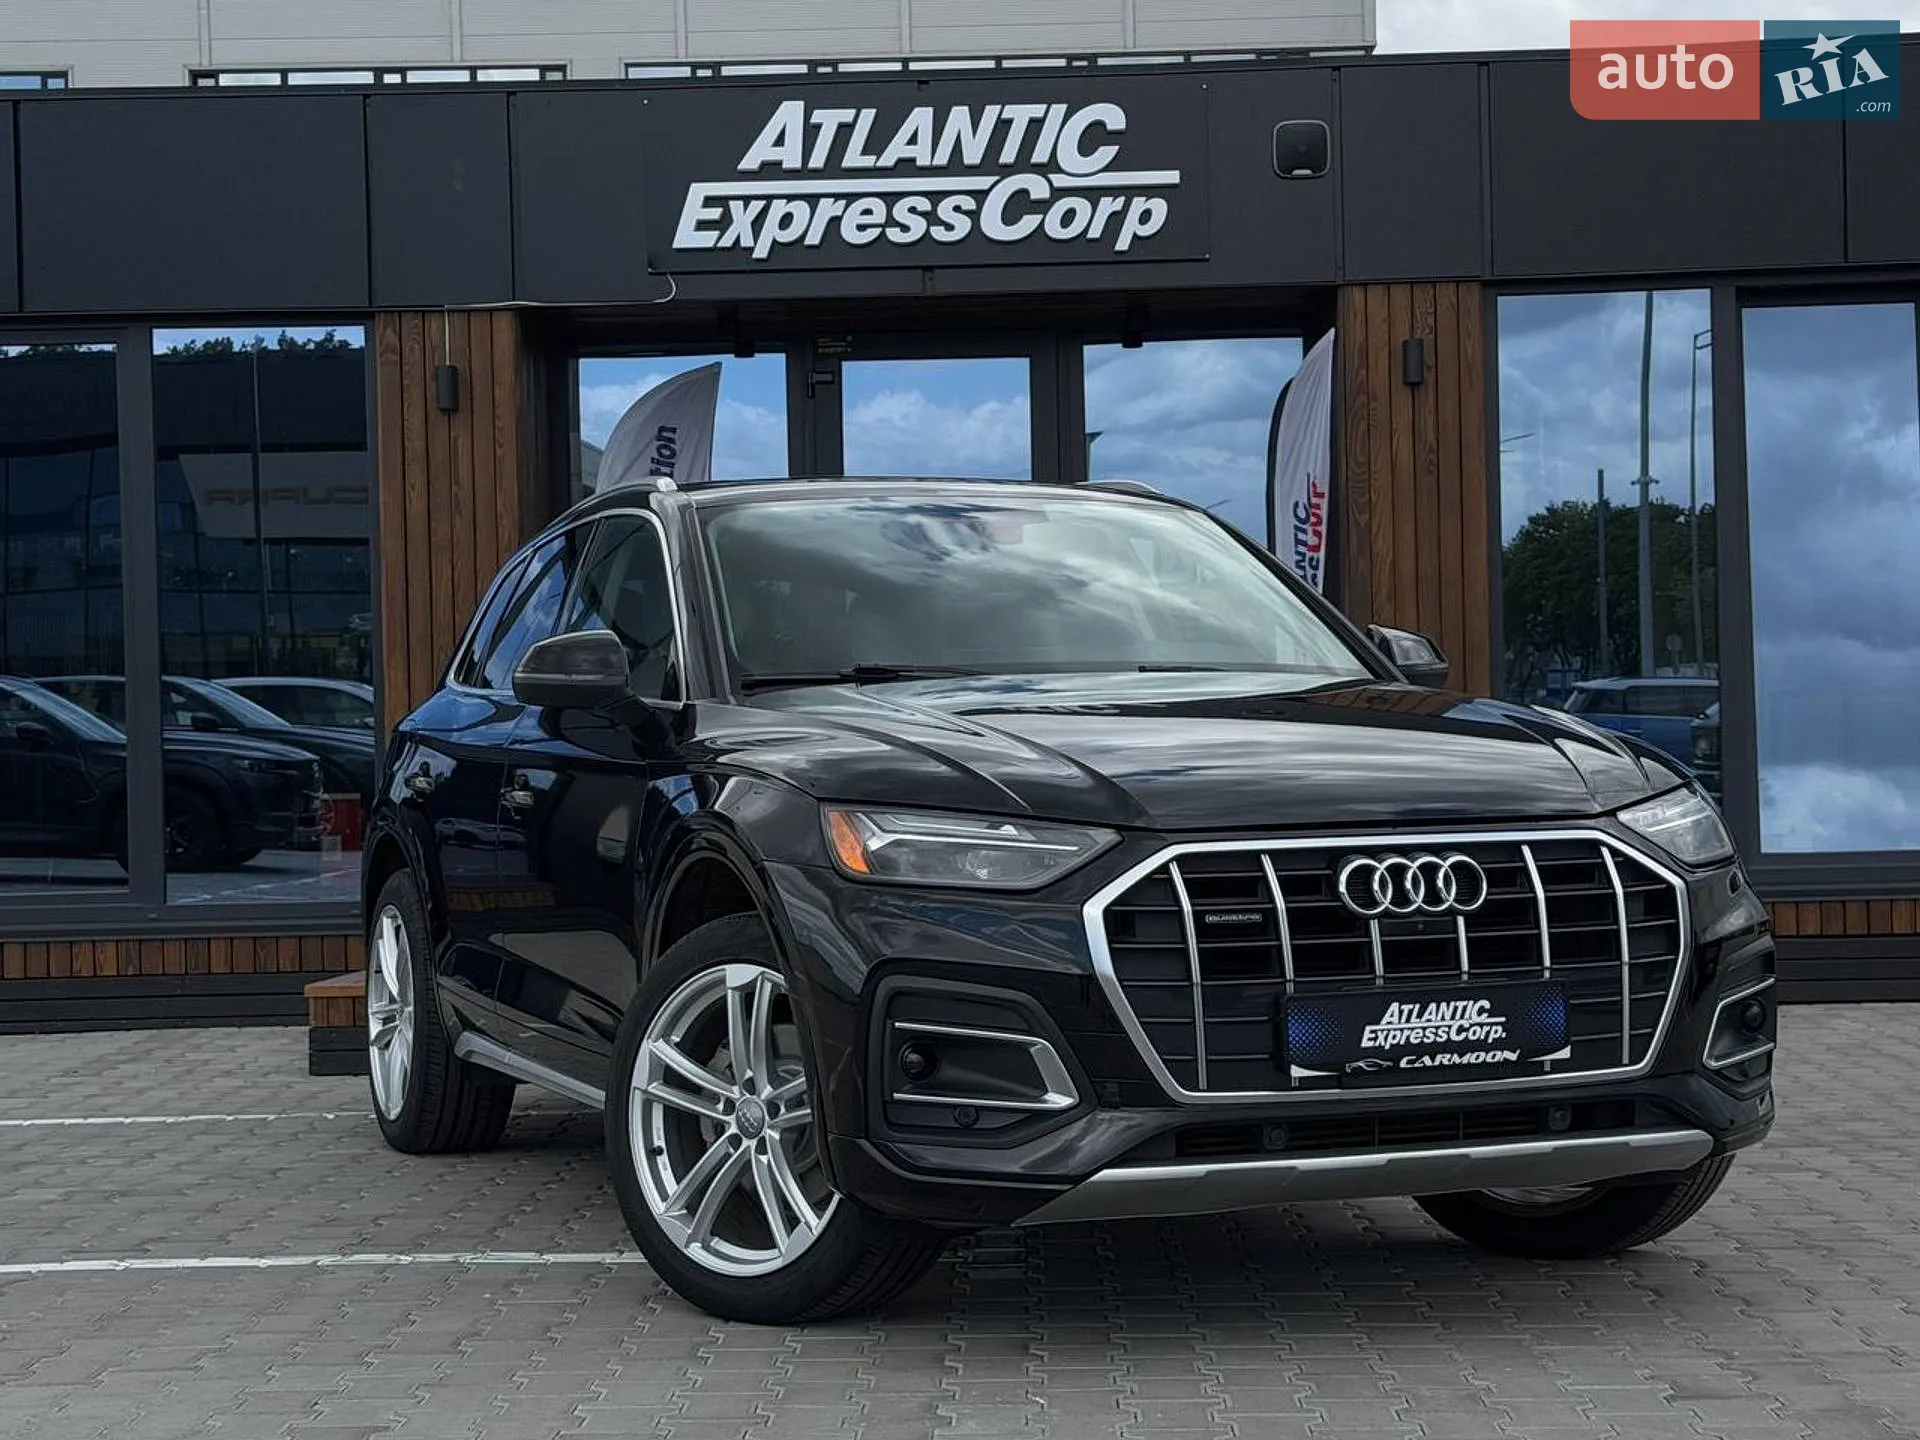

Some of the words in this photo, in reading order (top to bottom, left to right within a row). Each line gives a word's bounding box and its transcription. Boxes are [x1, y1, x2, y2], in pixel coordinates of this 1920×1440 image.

[737, 100, 1126, 175] ATLANTIC
[672, 174, 1168, 260] ExpressCorp
[1381, 999, 1491, 1026] ATLANTIC
[1361, 1020, 1507, 1049] ExpressCorp.
[1400, 1050, 1520, 1068] CARMOON
